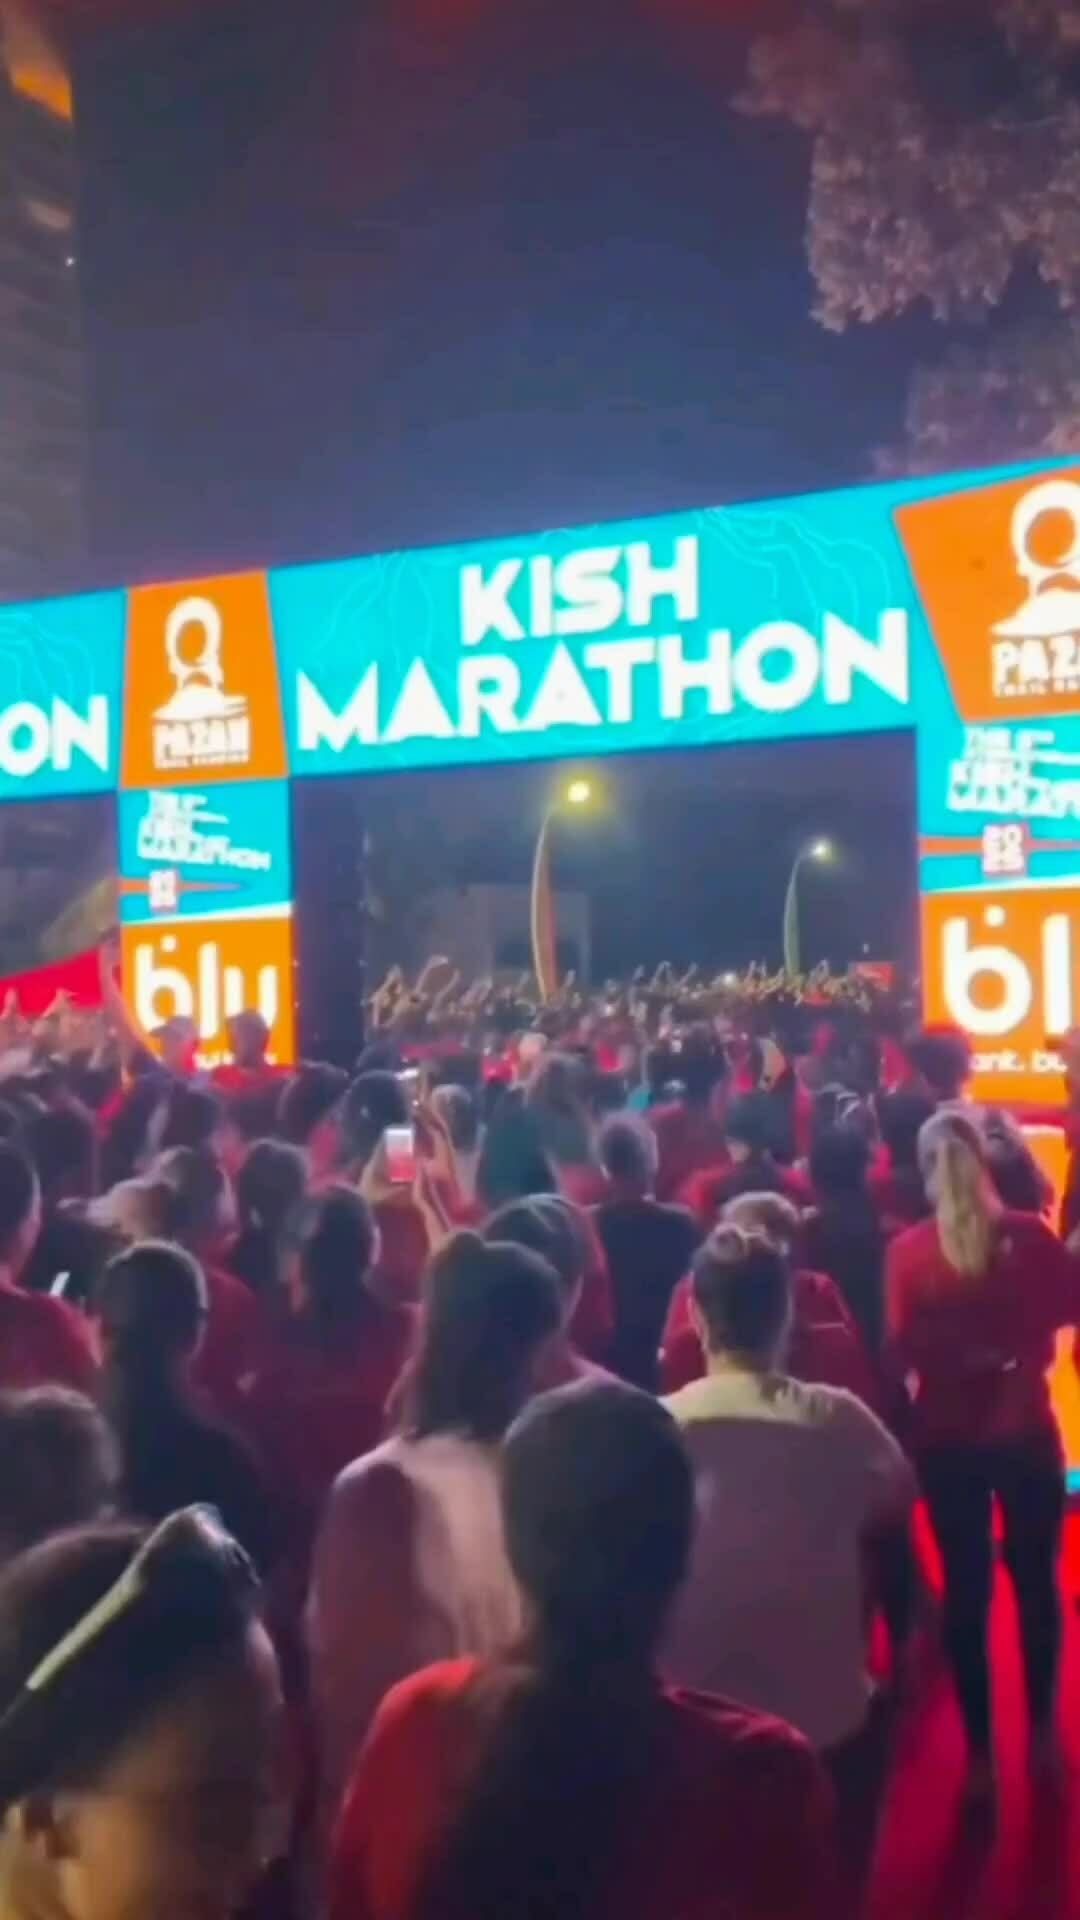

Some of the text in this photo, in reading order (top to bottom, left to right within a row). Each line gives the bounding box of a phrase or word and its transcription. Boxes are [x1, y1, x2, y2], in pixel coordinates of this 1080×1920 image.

[459, 533, 698, 646] KISH
[297, 607, 909, 753] MARATHON
[0, 693, 109, 778] ON
[134, 935, 278, 1039] blu
